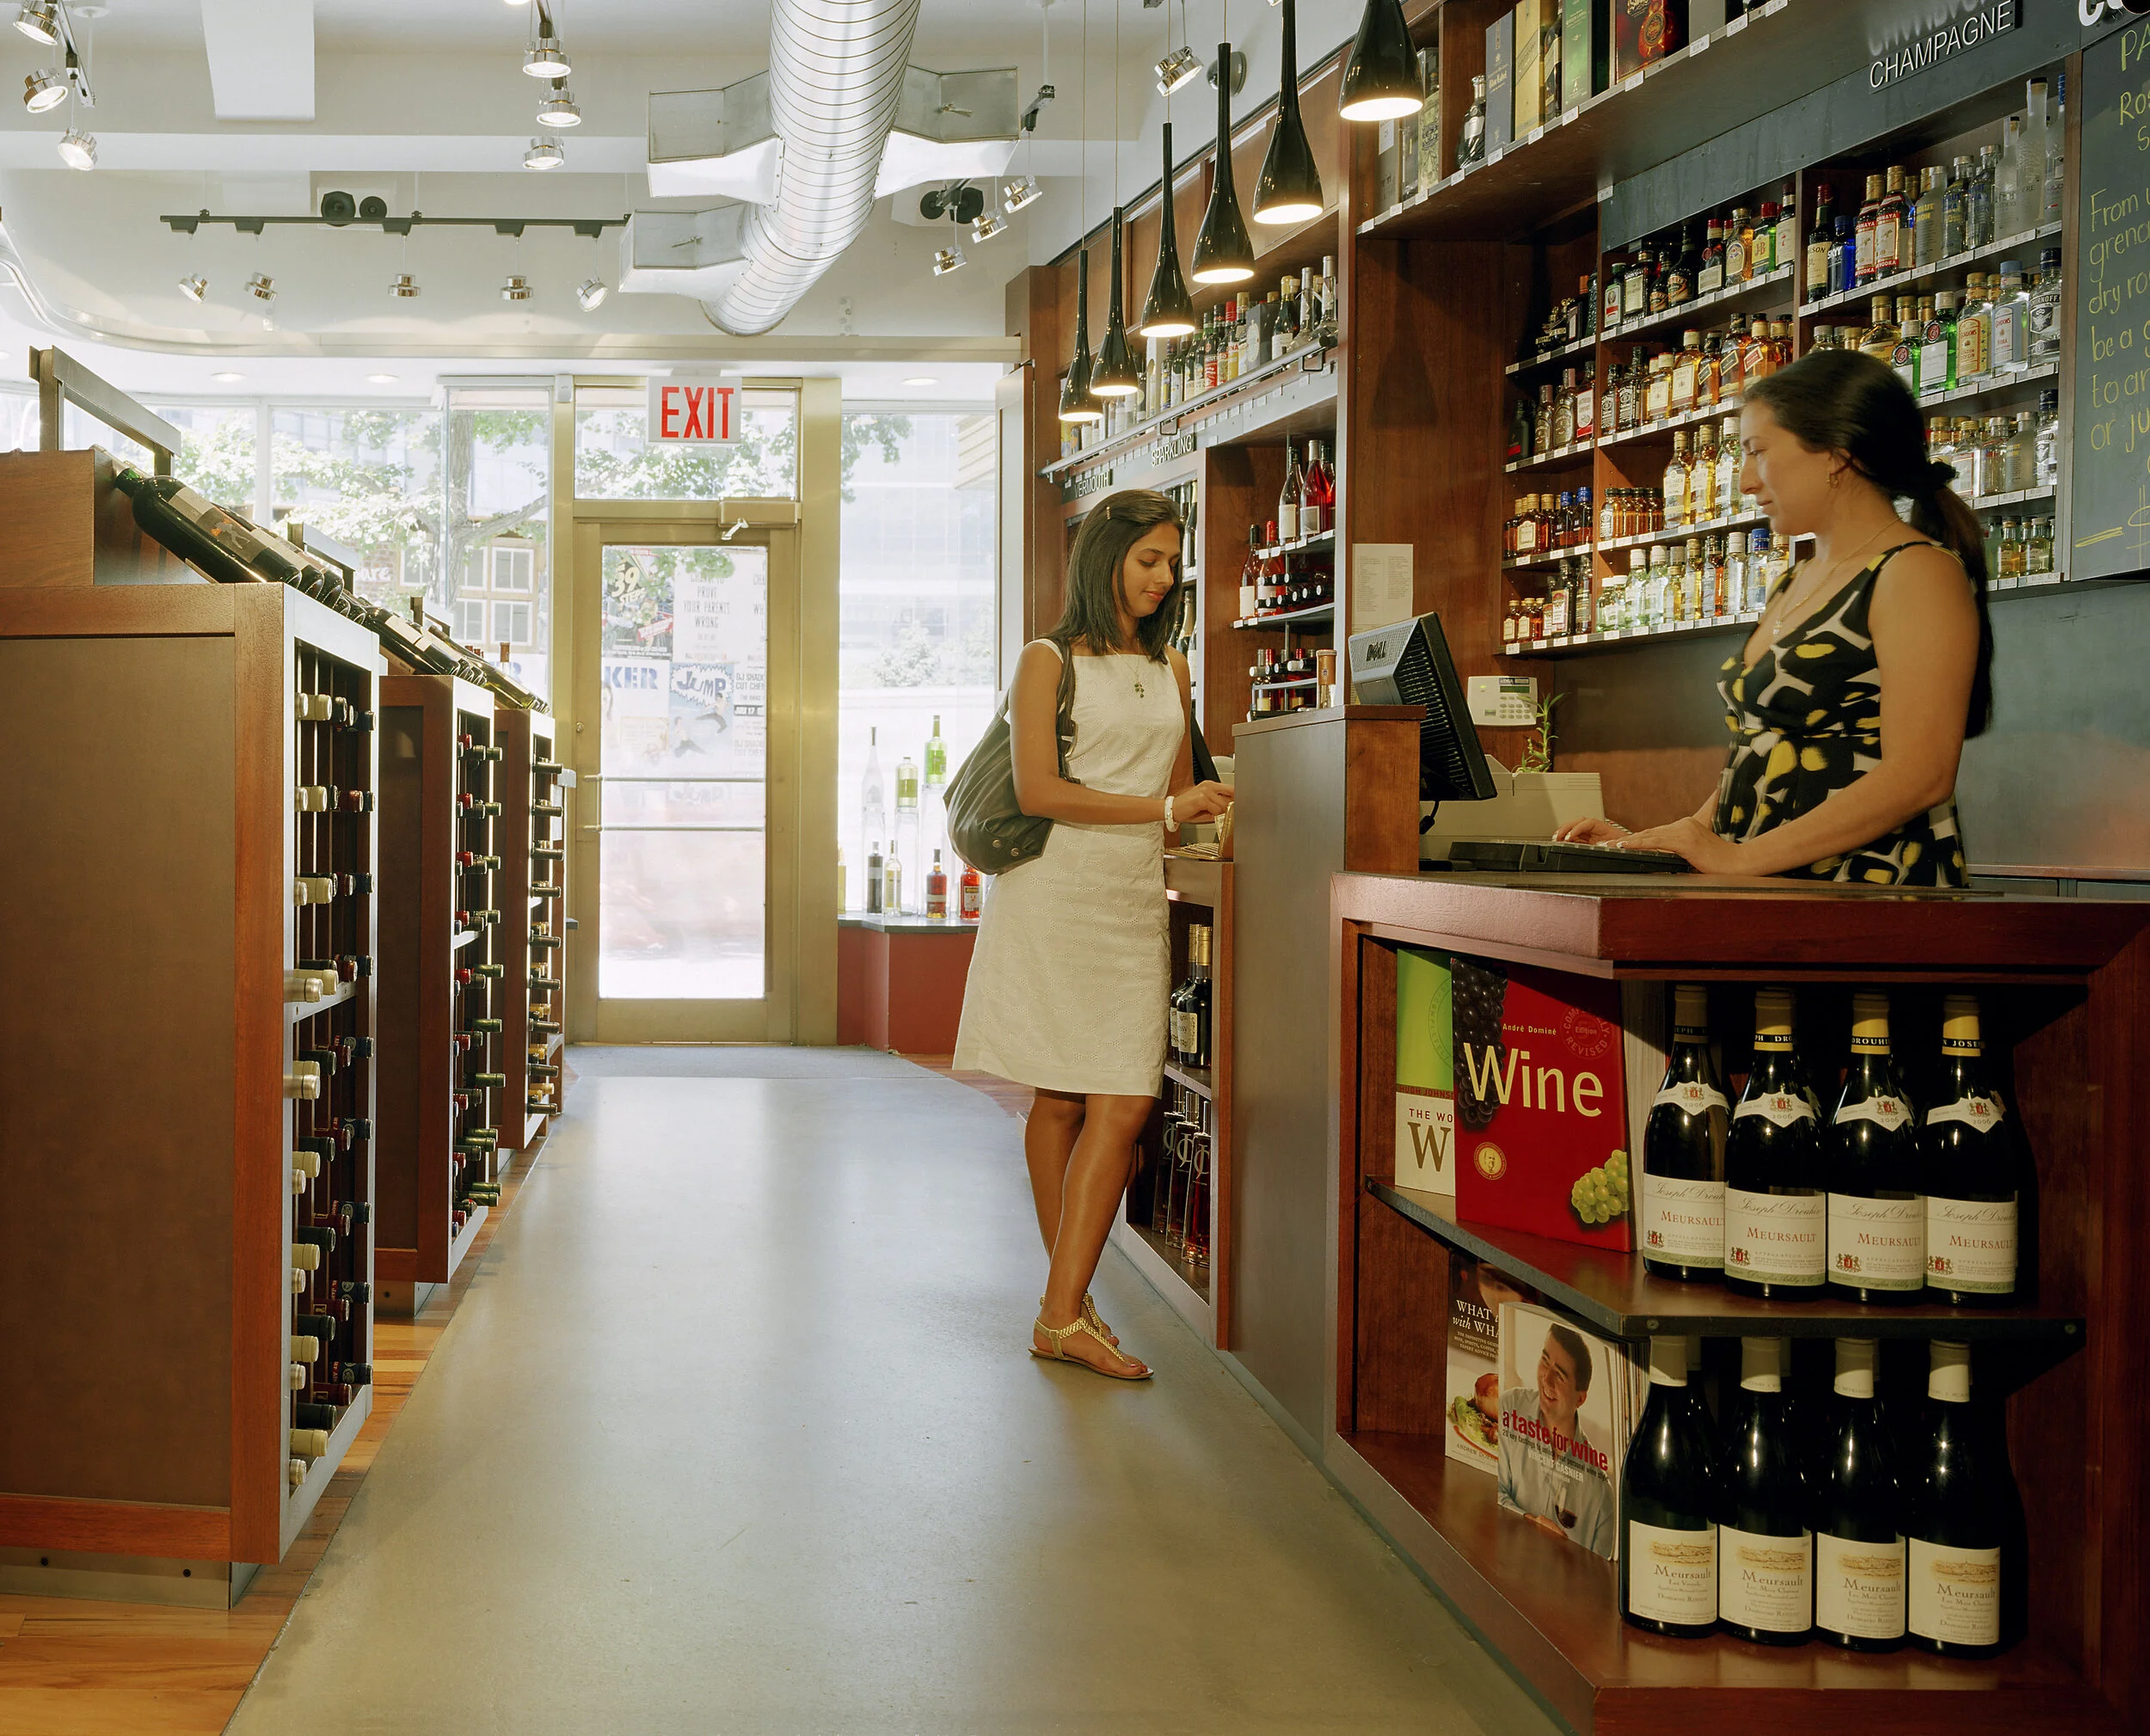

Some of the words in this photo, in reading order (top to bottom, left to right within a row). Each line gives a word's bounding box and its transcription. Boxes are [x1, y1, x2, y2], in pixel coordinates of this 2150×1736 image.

[1869, 0, 2012, 89] CHAMPAGNE
[2091, 188, 2139, 232] From
[2089, 281, 2120, 315] dry
[2091, 326, 2115, 362] be
[2120, 328, 2133, 349] a
[2092, 374, 2120, 408] to
[660, 386, 734, 439] EXIT
[2091, 420, 2116, 450] or
[1151, 434, 1192, 467] SPARKLING
[1074, 471, 1109, 499] VERMOUTH
[611, 567, 640, 598] 39
[697, 586, 718, 598] PROVE
[683, 600, 701, 613] YOUR
[703, 601, 730, 614] PARENTS
[695, 616, 719, 629] WRONG
[604, 666, 659, 690] KER
[676, 671, 726, 696] JUMP
[735, 682, 747, 690] CUT
[736, 672, 746, 681] DJ
[1502, 1023, 1524, 1033] André
[1528, 1025, 1557, 1035] Dominé
[1576, 1026, 1597, 1035] Edition
[1566, 1036, 1607, 1056] REVISED
[1463, 1042, 1604, 1117] Wine
[1400, 1086, 1422, 1095] HUGH
[1409, 1108, 1430, 1120] THE
[1436, 1112, 1453, 1123] WO
[1407, 1121, 1451, 1172] W
[1742, 1197, 1778, 1215] Joseph
[1851, 1203, 1891, 1220] Joseph
[1939, 1205, 1981, 1221] Joseph
[1747, 1227, 1816, 1242] MEURSAULT
[1456, 1299, 1492, 1321] WHAT
[1453, 1315, 1471, 1329] with
[1502, 1411, 1510, 1427] a
[1511, 1409, 1551, 1445] taste
[1552, 1426, 1569, 1453] for
[1570, 1438, 1608, 1471] wine
[1527, 1447, 1554, 1469] VINCENT
[1555, 1463, 1584, 1483] GASNIER
[1655, 1564, 1711, 1580] Meursault
[1742, 1569, 1803, 1586] Meursault
[1844, 1578, 1901, 1592] Meursault
[1938, 1583, 1996, 1598] Meursault
